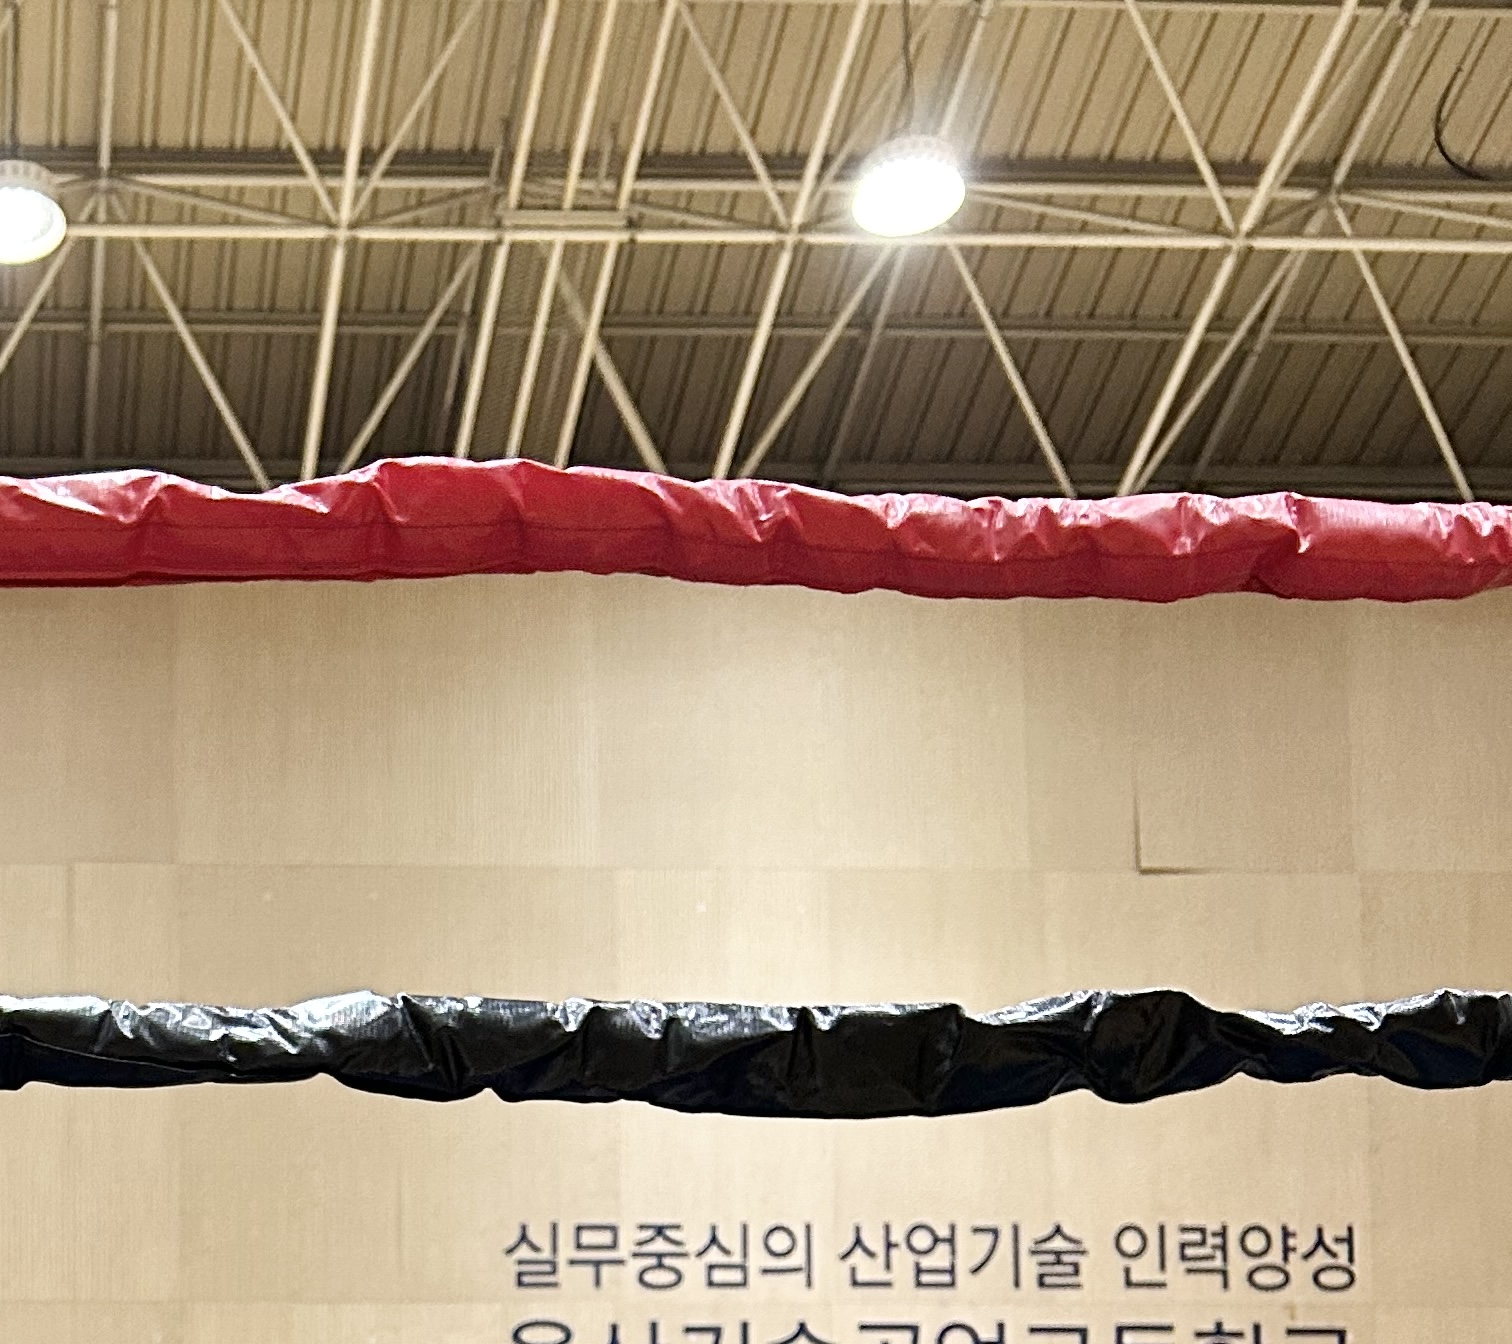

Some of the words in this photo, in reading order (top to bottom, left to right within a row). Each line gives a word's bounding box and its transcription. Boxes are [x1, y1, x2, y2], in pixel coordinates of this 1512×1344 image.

[505, 1222, 811, 1290] 실무중심의
[840, 1224, 1087, 1289] 산업기술
[1115, 1224, 1355, 1292] 인력양성
